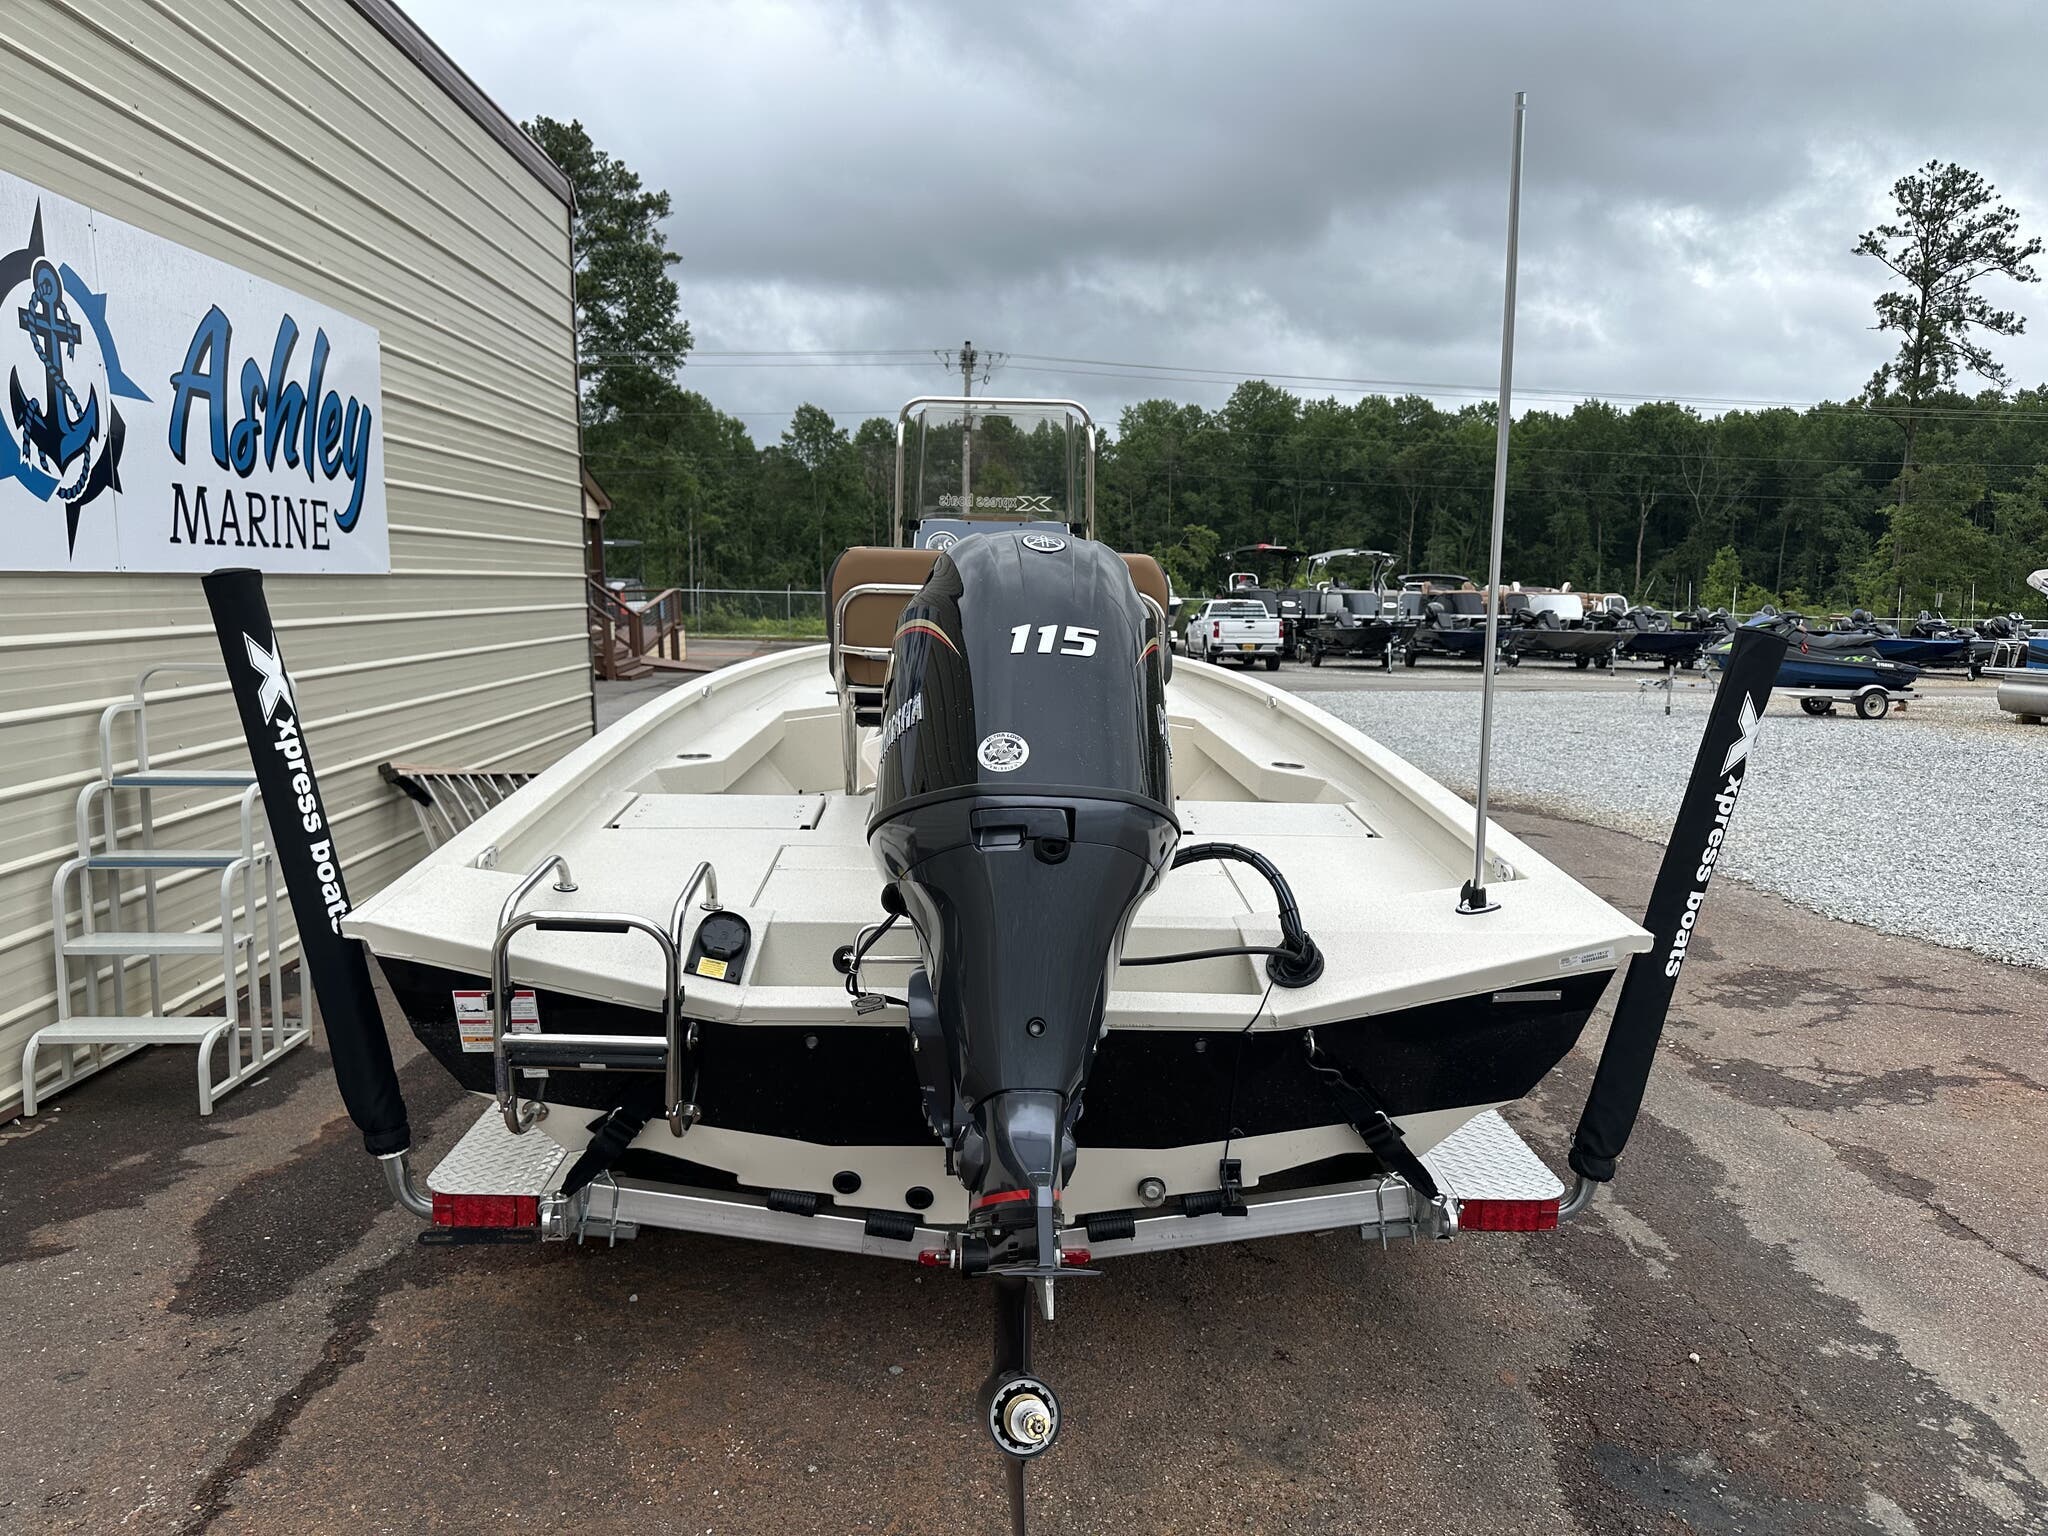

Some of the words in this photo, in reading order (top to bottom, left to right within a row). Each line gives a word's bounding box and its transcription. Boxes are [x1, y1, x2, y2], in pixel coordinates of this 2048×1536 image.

[168, 303, 372, 533] Ashley
[169, 483, 330, 551] MARINE
[1010, 623, 1100, 658] 115
[274, 714, 323, 834] xpress
[1695, 773, 1742, 883] xpress
[1665, 890, 1706, 978] boats
